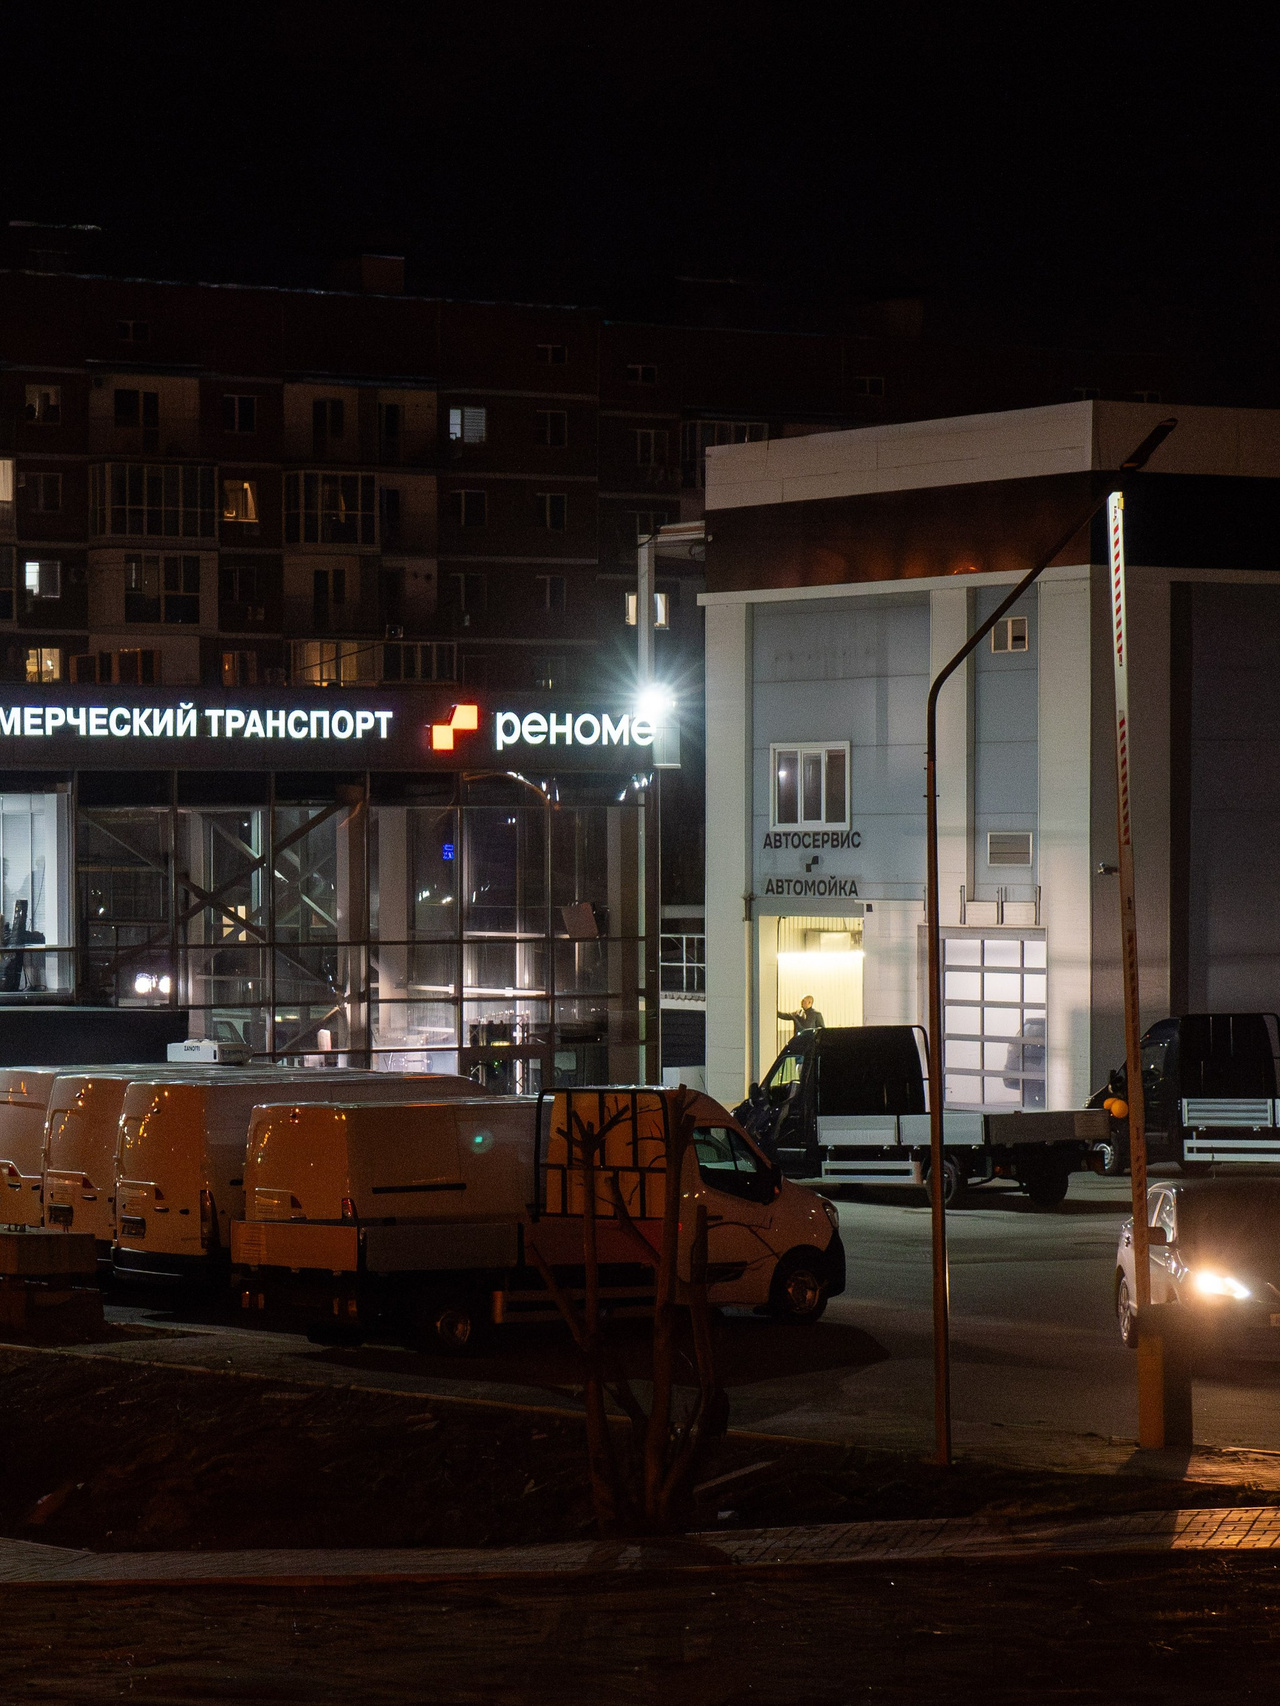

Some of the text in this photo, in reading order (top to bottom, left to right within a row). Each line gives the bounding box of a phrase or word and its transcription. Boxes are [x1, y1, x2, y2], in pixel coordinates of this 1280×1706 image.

[205, 709, 394, 739] ТРАНСПОРТ
[496, 711, 657, 751] реноме
[763, 831, 862, 849] АВТОСЕРВИС
[765, 875, 859, 897] АВТОМОЙКА
